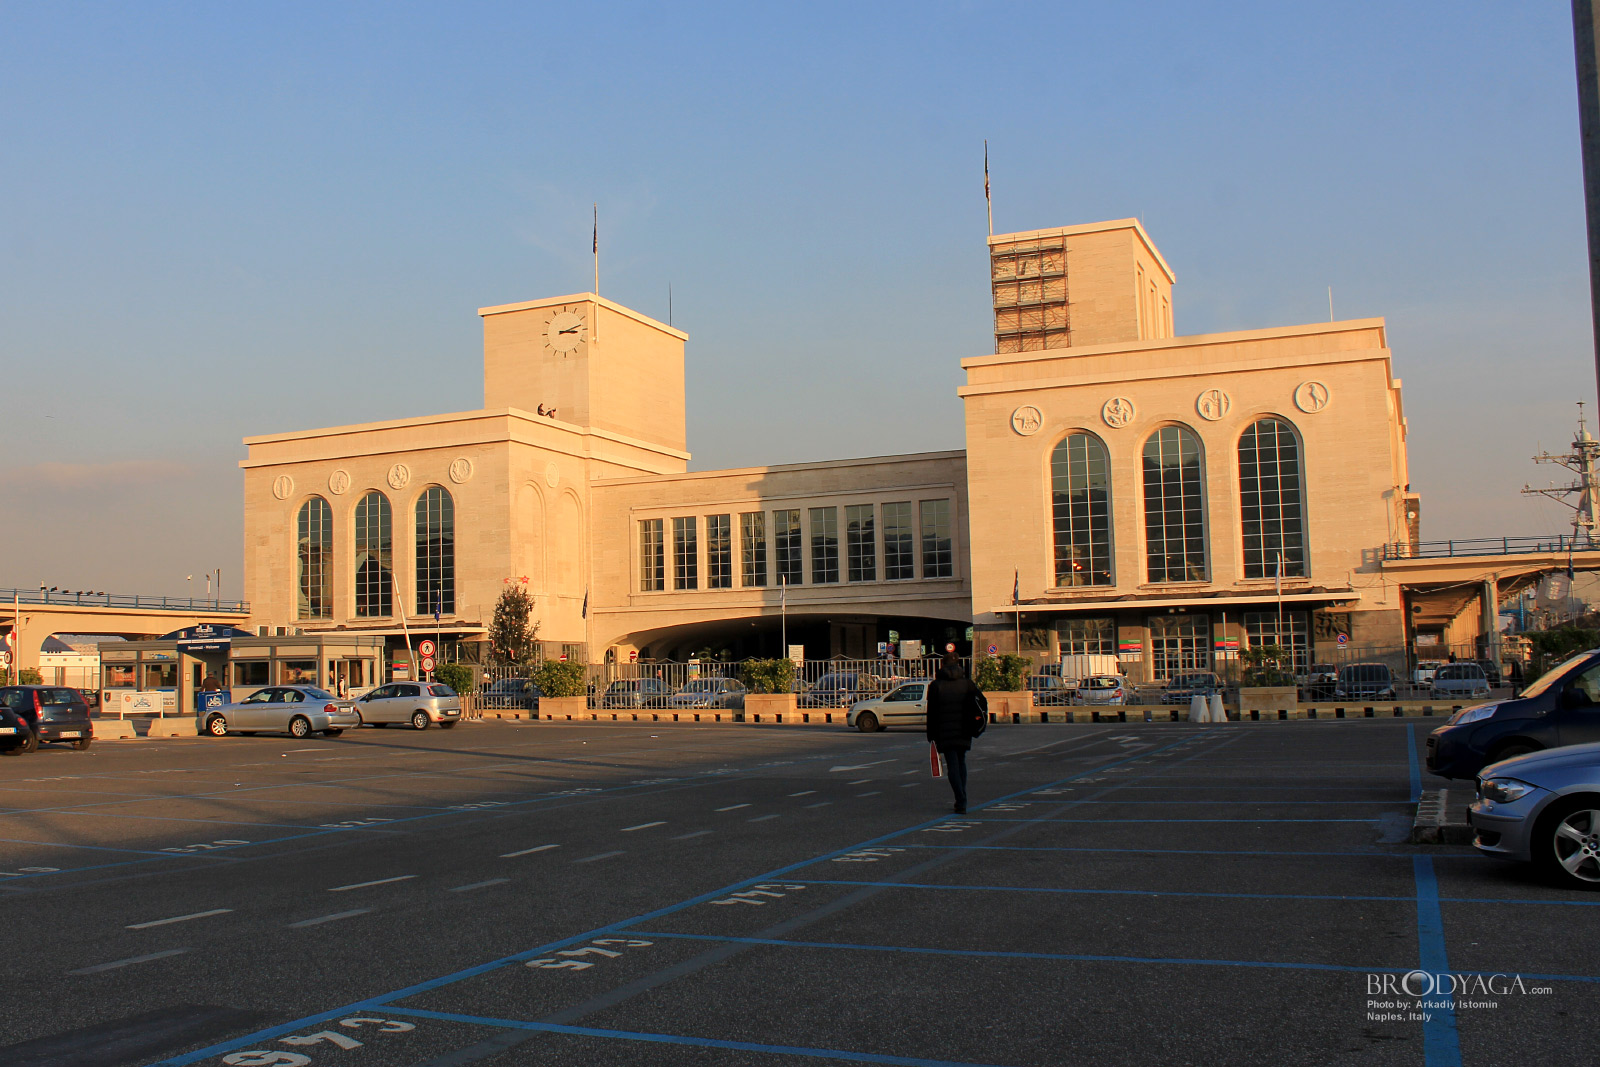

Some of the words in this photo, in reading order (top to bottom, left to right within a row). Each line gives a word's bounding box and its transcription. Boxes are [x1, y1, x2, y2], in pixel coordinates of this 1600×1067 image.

[831, 848, 906, 862] C43
[709, 884, 807, 905] C44
[525, 938, 654, 971] C45
[222, 1017, 417, 1067] C46
